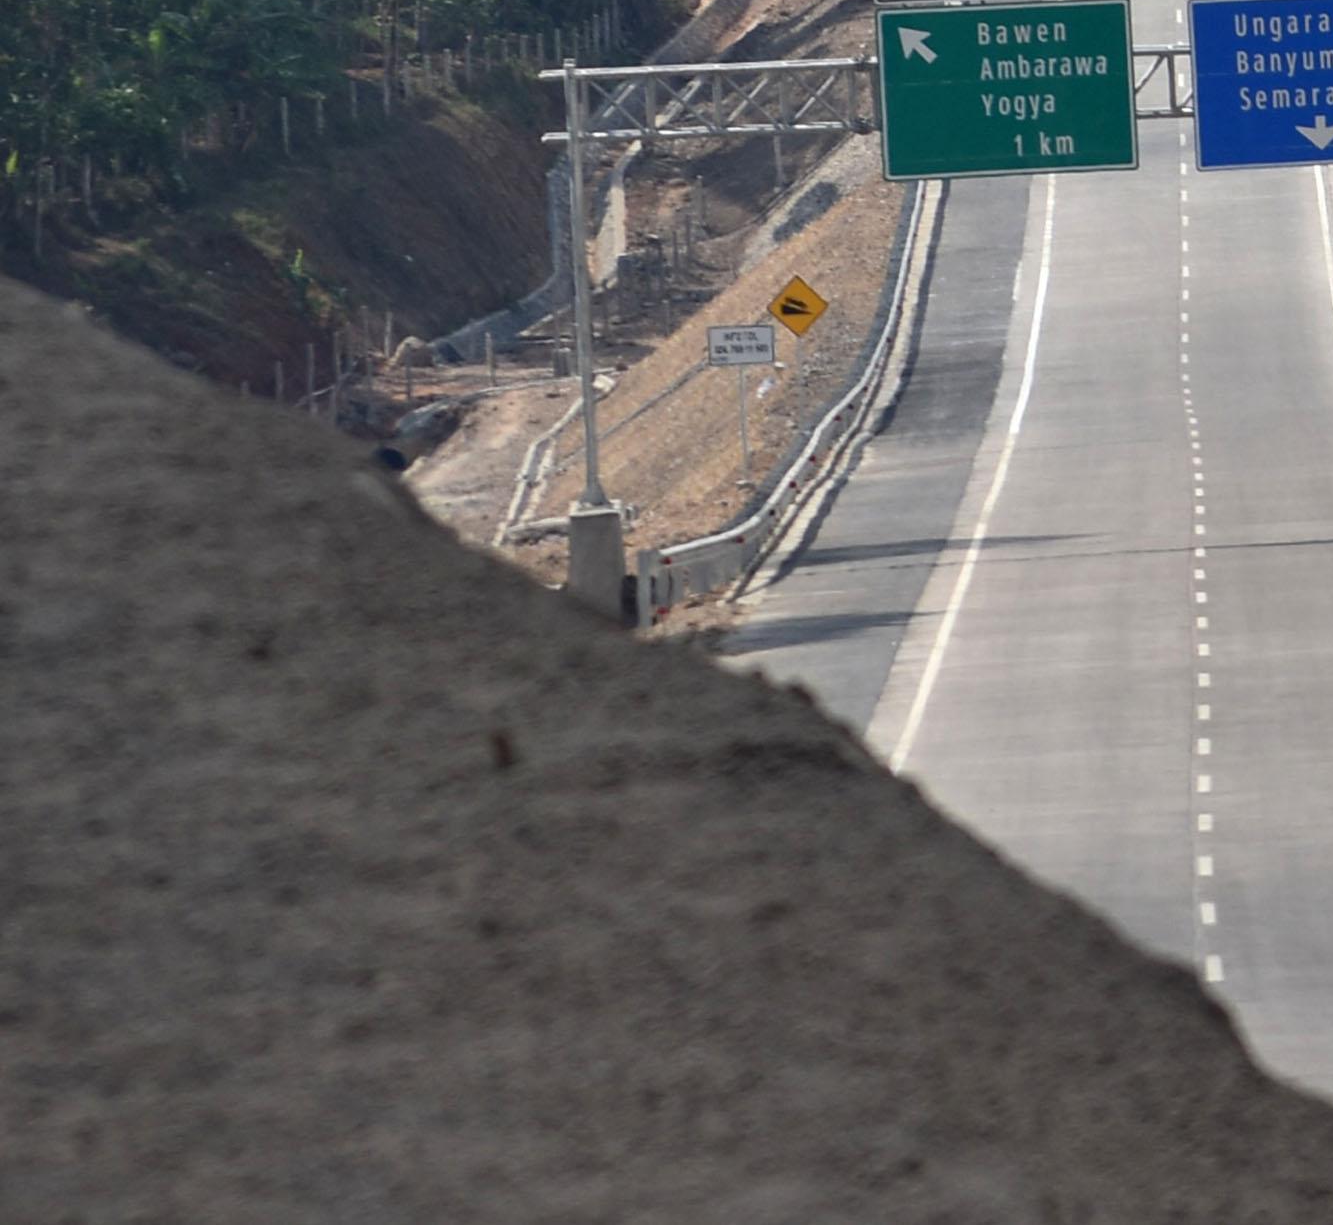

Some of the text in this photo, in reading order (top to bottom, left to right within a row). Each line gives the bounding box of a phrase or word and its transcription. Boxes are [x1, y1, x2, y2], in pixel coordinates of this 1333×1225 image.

[977, 22, 1067, 45] Bawen
[980, 54, 1108, 81] Ambarawa
[981, 93, 1056, 120] Yogya
[1014, 131, 1076, 157] 1 km
